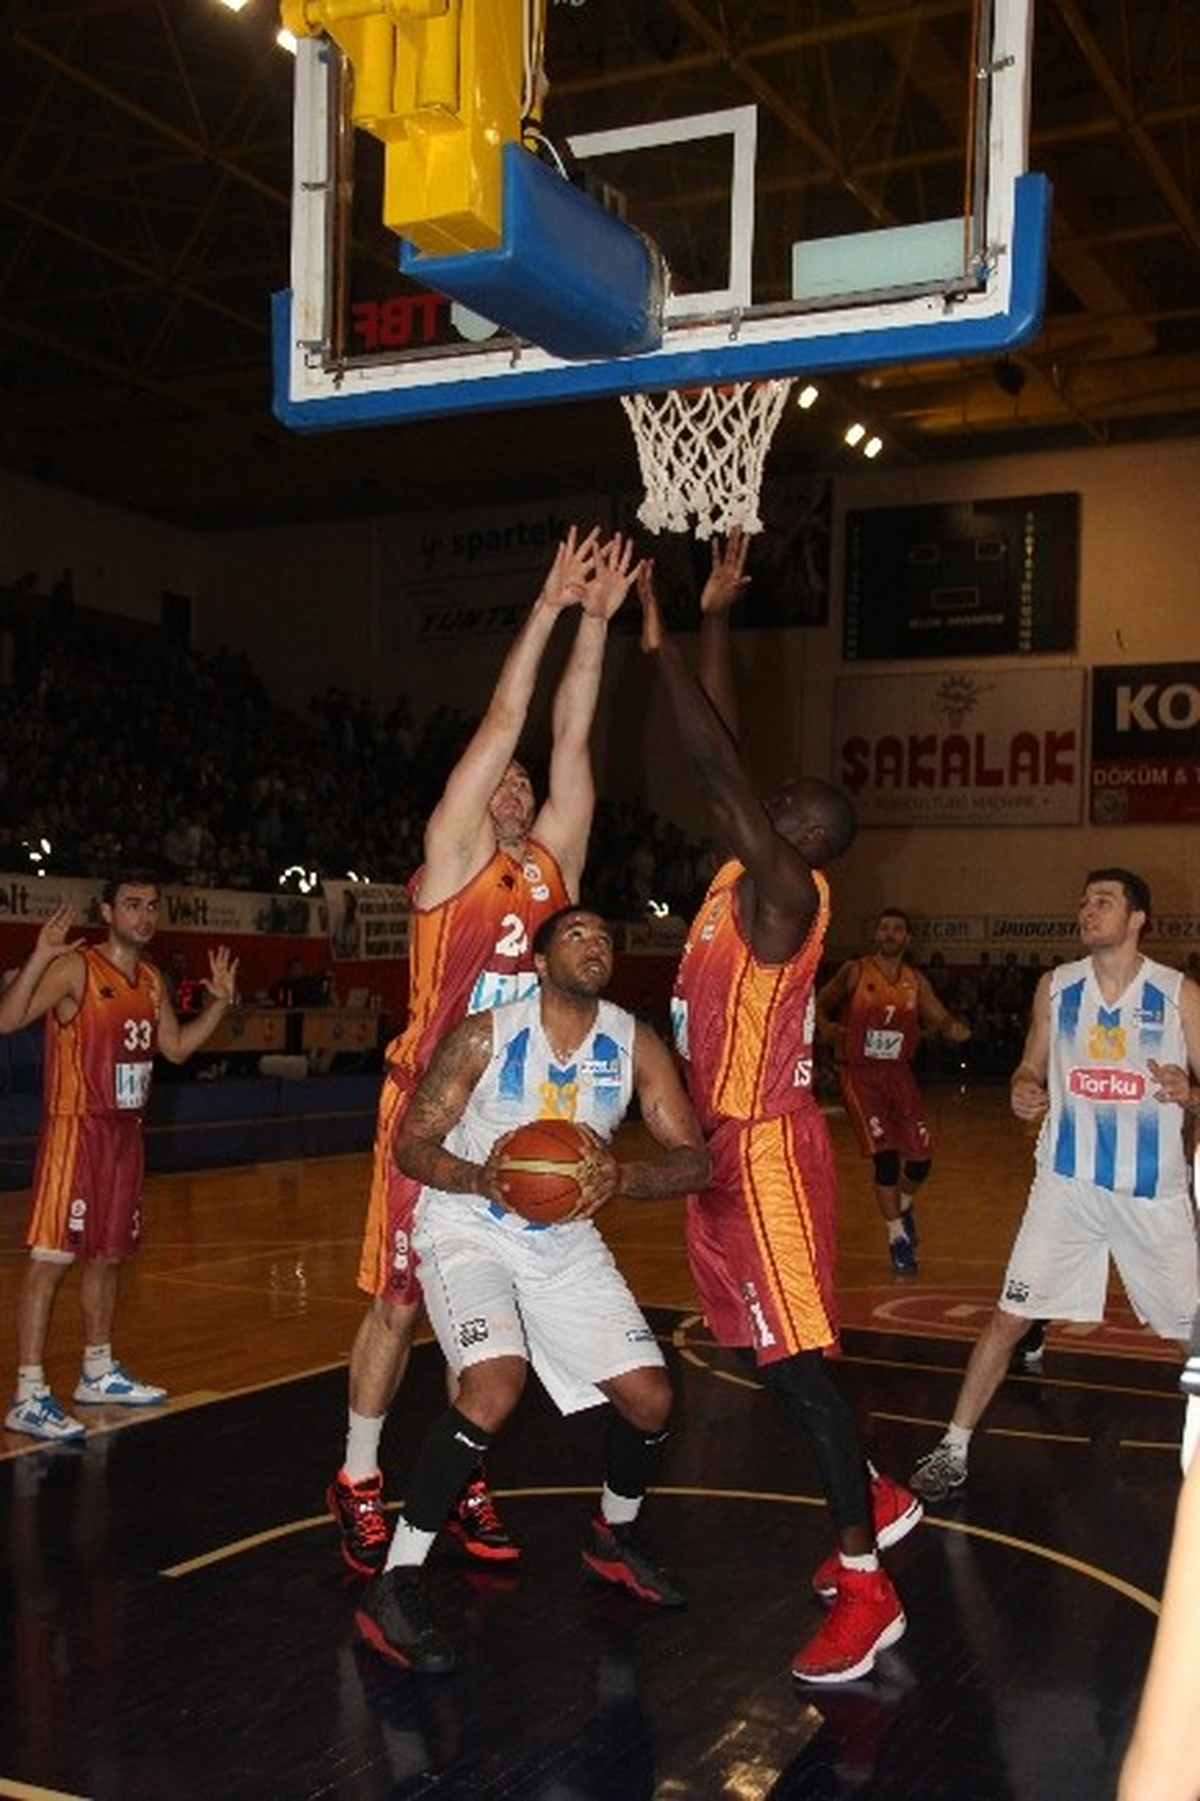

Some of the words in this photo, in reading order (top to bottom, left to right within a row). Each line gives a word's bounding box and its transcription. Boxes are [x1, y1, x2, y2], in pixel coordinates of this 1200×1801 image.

[885, 1004, 897, 1026] 7
[123, 1018, 153, 1052] 33
[1075, 1071, 1139, 1096] Torku
